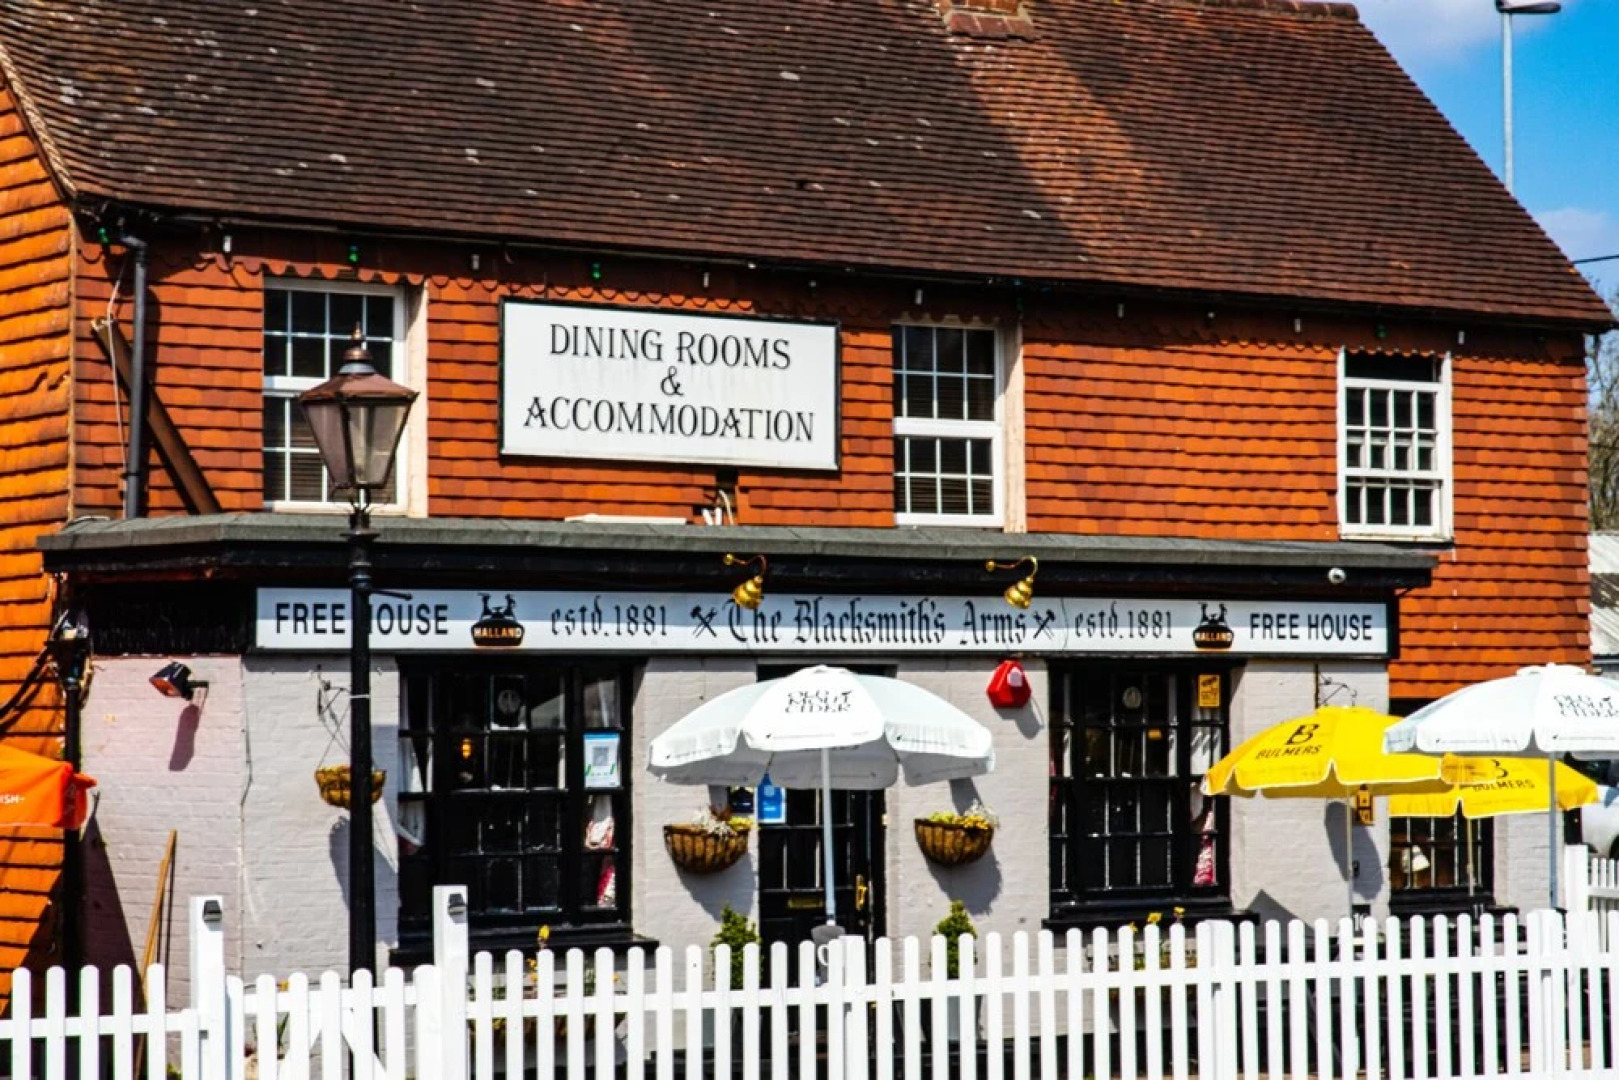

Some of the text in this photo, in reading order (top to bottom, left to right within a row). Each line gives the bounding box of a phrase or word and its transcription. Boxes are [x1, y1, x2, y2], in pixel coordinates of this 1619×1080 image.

[550, 323, 792, 370] DINING ROOMS
[660, 365, 685, 397] &
[524, 396, 815, 443] ACCOMMODATION
[275, 603, 448, 636] FREE OUSE
[722, 597, 1027, 645] The Blacksmith's Arms
[1250, 612, 1373, 641] FREE HOUSE
[1256, 744, 1322, 760] BULMERS
